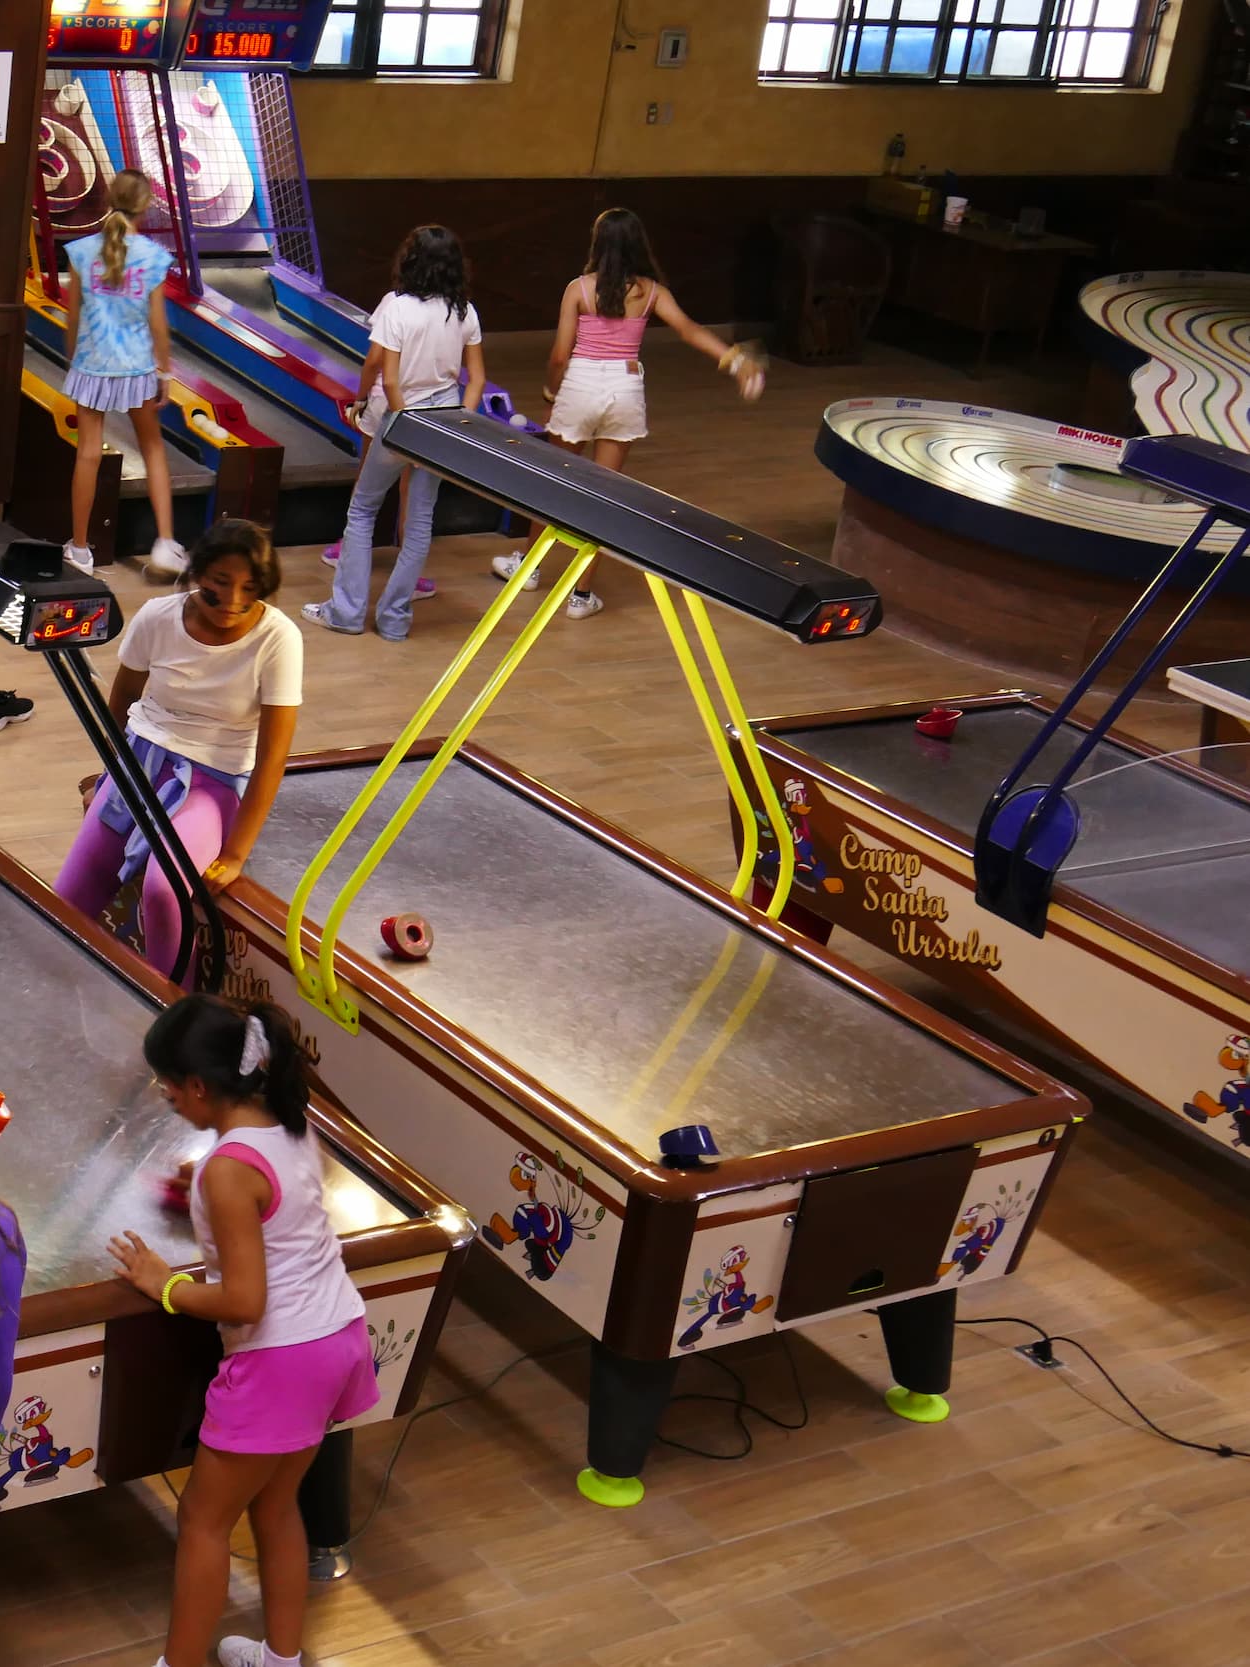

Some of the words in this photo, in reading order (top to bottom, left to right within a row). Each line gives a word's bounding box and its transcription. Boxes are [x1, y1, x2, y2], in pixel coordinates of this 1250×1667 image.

[74, 17, 129, 28] SCORE
[216, 22, 267, 32] SCORE
[120, 28, 132, 51] 0
[1057, 426, 1084, 439] MIKI
[1084, 431, 1124, 448] HOUSE
[839, 833, 923, 888] Camp
[862, 876, 950, 922] Santa
[891, 918, 1003, 971] Ursula
